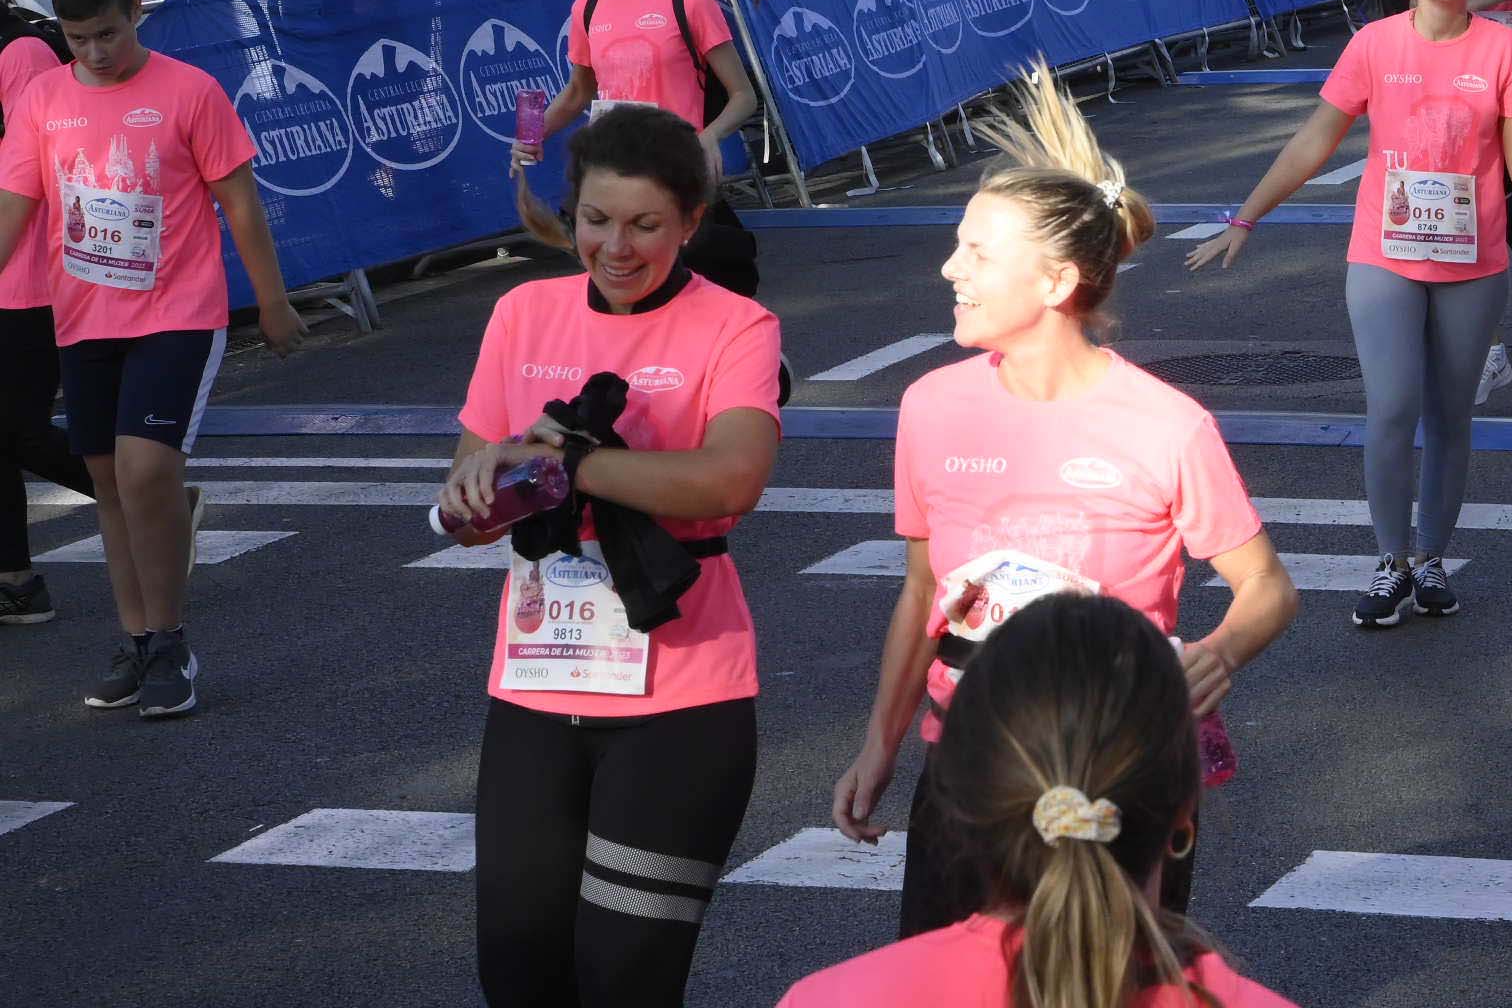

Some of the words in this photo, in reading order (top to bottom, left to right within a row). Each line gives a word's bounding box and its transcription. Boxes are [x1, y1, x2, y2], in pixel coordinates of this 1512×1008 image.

[1384, 73, 1423, 85] OYSHO
[46, 117, 88, 131] OYSHO
[359, 92, 457, 143] ASTURIANA
[1382, 149, 1408, 170] TU
[1412, 207, 1445, 220] 016
[88, 225, 122, 243] 016
[1417, 223, 1438, 232] 8749
[91, 243, 113, 255] 3201
[521, 362, 582, 382] OYSHO
[944, 456, 1007, 474] OYSHO
[553, 565, 602, 581] ASTURIANA
[548, 600, 596, 622] 016
[553, 627, 582, 641] 9813
[551, 647, 561, 656] DE
[563, 648, 574, 656] LA
[515, 666, 549, 679] OYSHO
